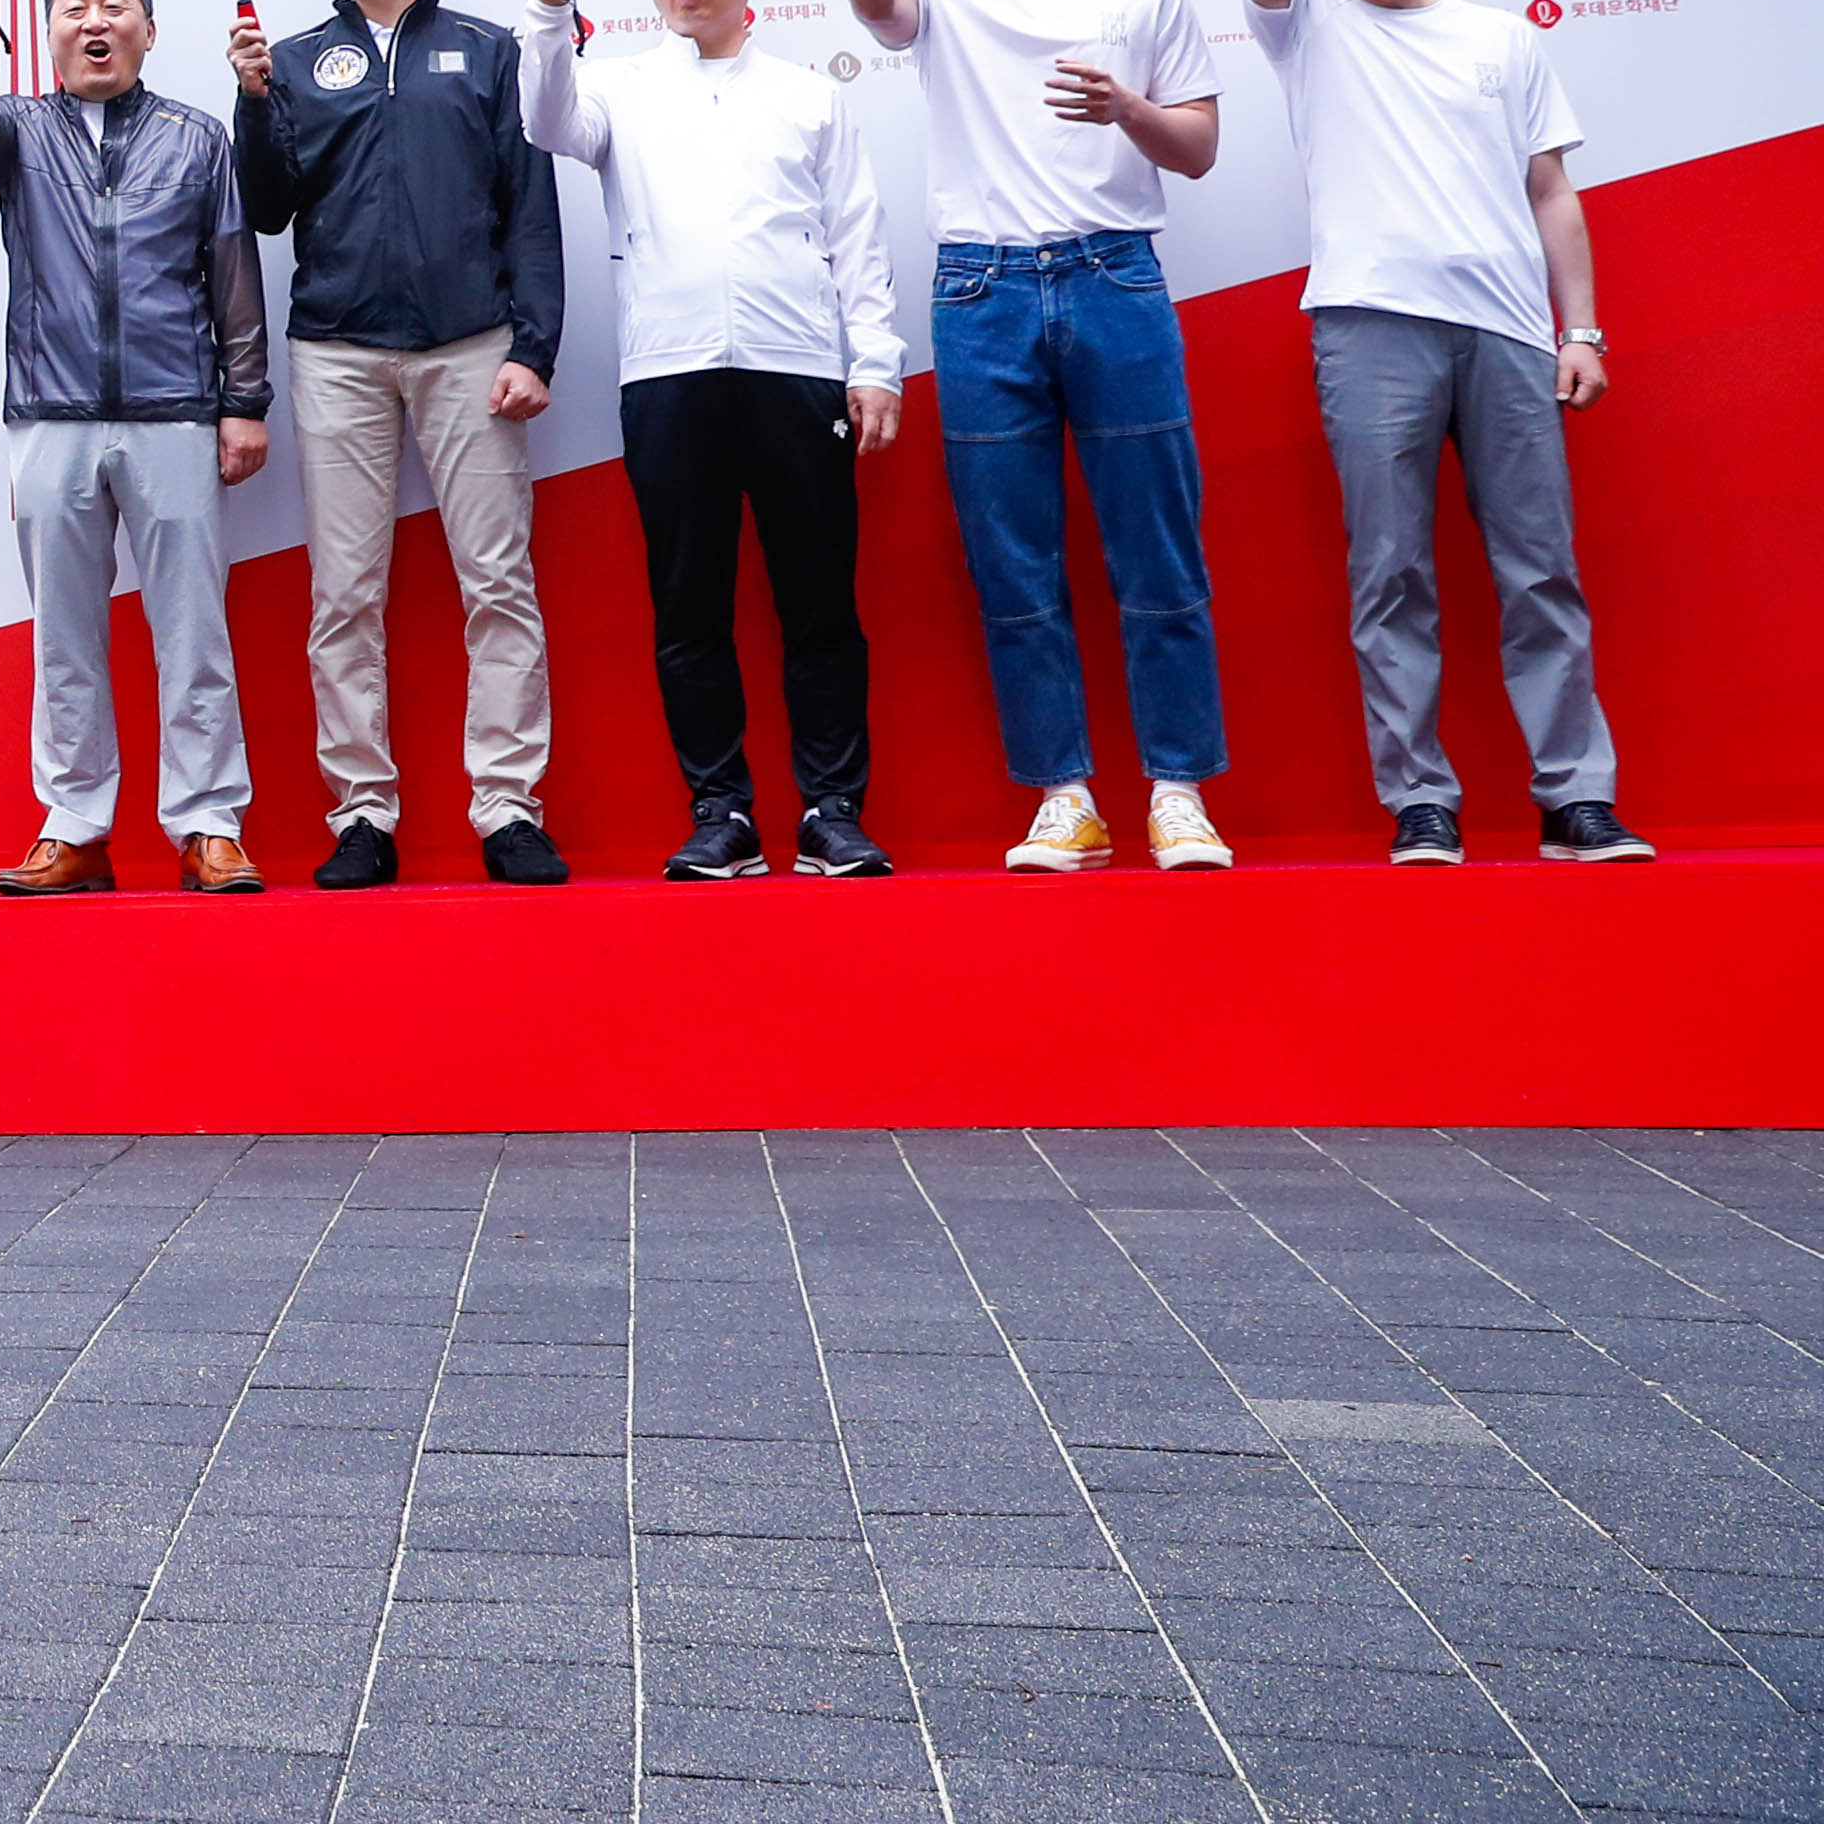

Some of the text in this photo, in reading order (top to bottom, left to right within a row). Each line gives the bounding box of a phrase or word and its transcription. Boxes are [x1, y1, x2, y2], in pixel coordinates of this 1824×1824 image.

[602, 2, 826, 34] 롯데칠성 롯데제과
[1207, 33, 1247, 44] LOTTE
[870, 54, 920, 72] 롯데백
